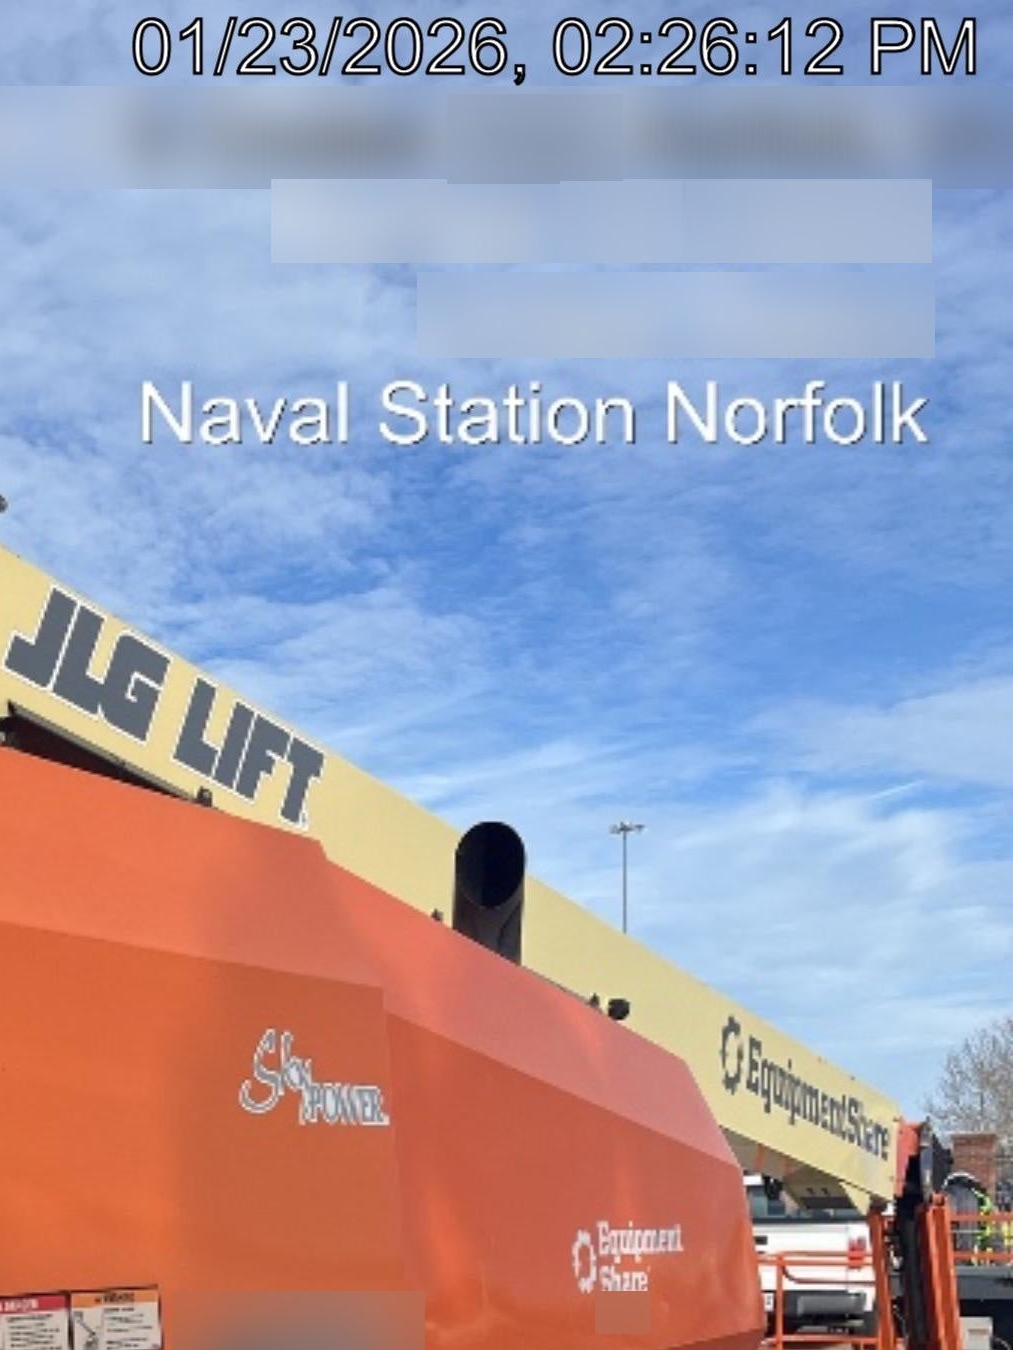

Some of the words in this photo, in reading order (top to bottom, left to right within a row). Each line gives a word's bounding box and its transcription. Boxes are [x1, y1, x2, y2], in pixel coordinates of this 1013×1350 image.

[0, 584, 171, 744] JLG
[172, 677, 325, 832] LIFT
[596, 1220, 684, 1264] Equipment
[598, 1264, 650, 1292] Share
